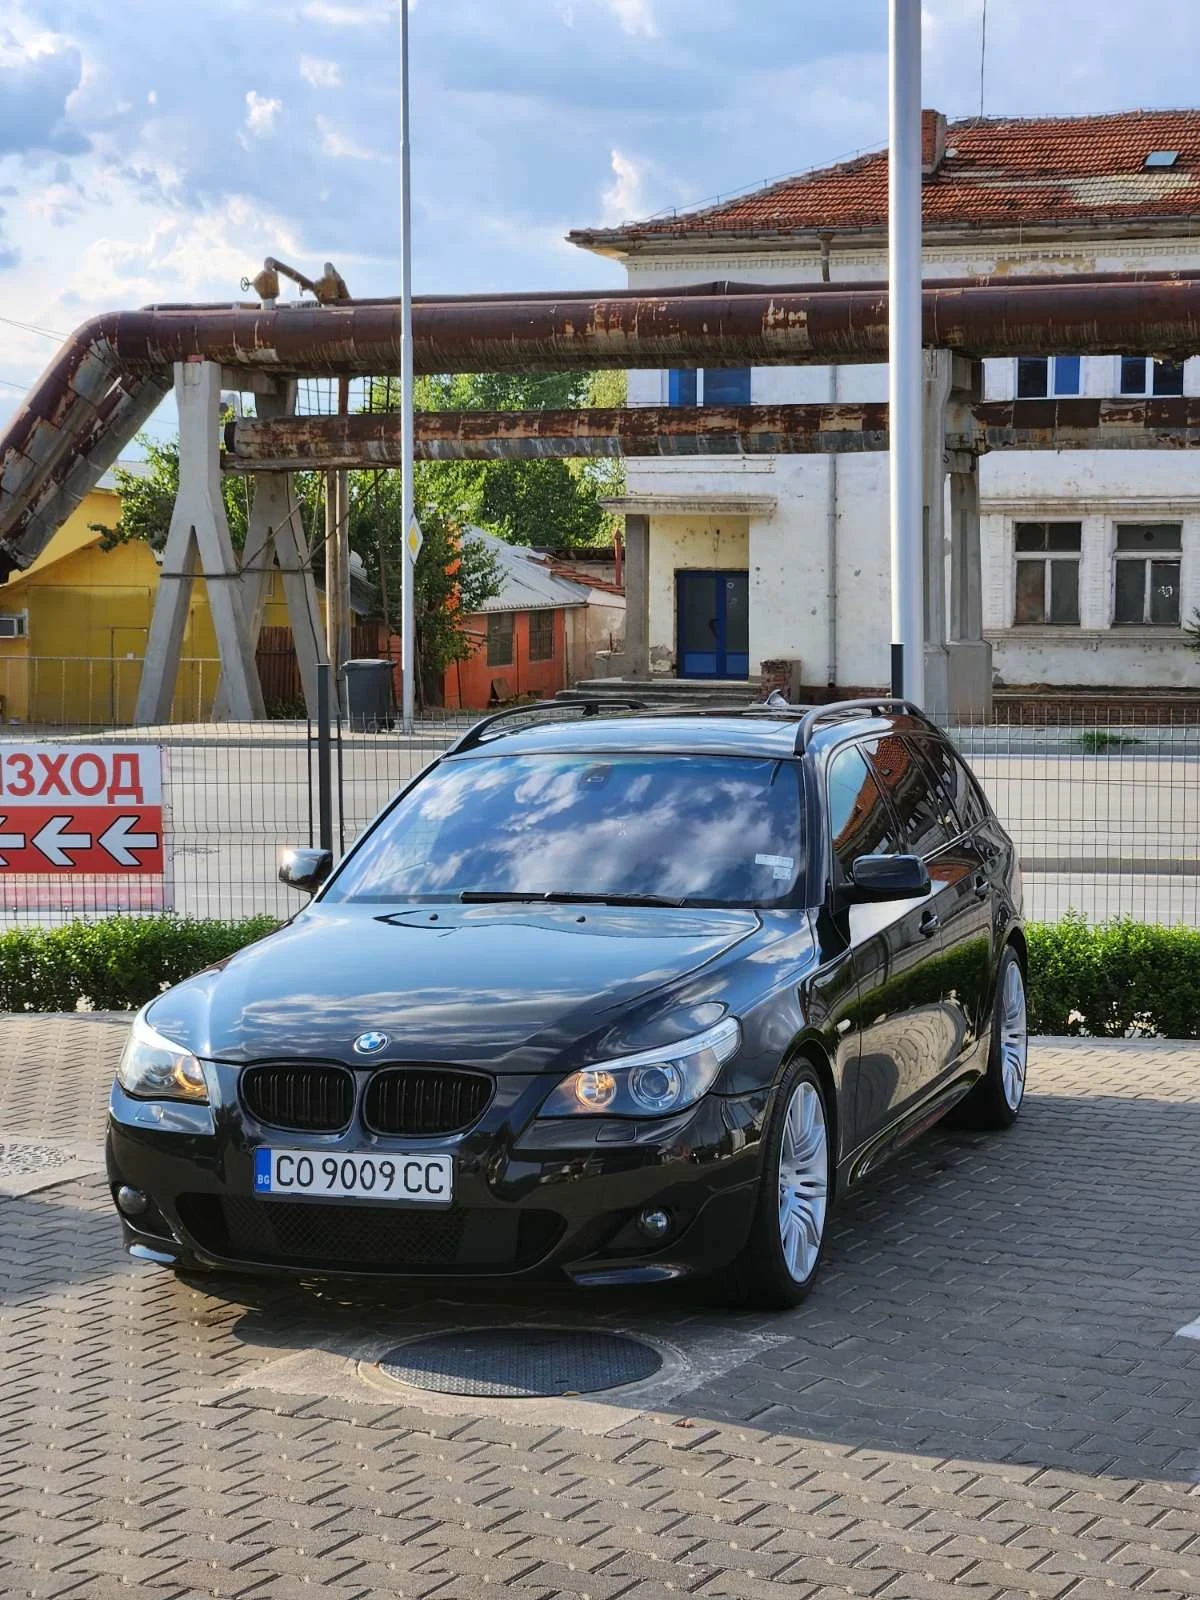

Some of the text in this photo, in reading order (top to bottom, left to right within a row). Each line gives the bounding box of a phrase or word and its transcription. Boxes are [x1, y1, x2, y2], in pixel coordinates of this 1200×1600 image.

[0, 753, 144, 804] ЗХОД
[257, 1174, 270, 1185] BG
[276, 1155, 444, 1194] CO 9009 CC
